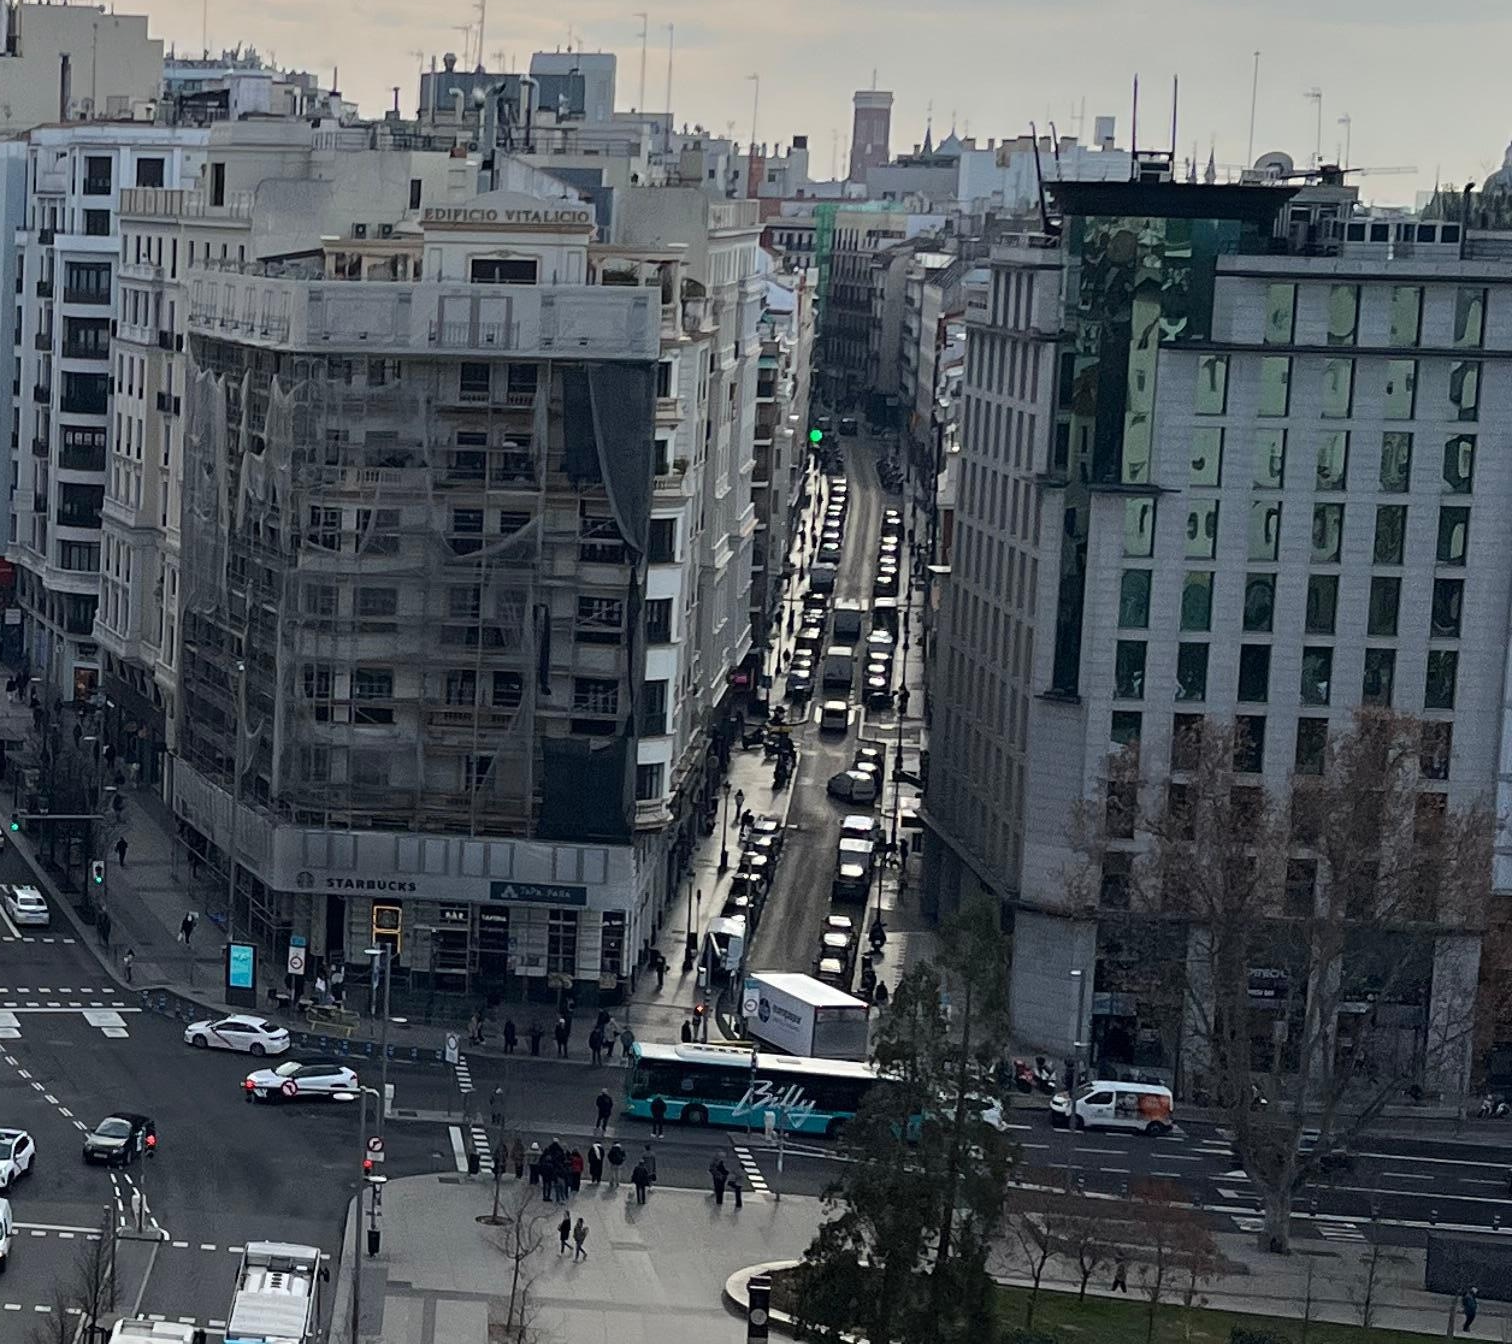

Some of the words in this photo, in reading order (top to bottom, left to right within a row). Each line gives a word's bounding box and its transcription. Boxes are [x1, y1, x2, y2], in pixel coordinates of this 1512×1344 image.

[424, 208, 498, 222] EDIFICIO
[505, 209, 588, 223] VITALICIO
[326, 878, 417, 892] STARBUCKS
[731, 1079, 816, 1129] Billy
